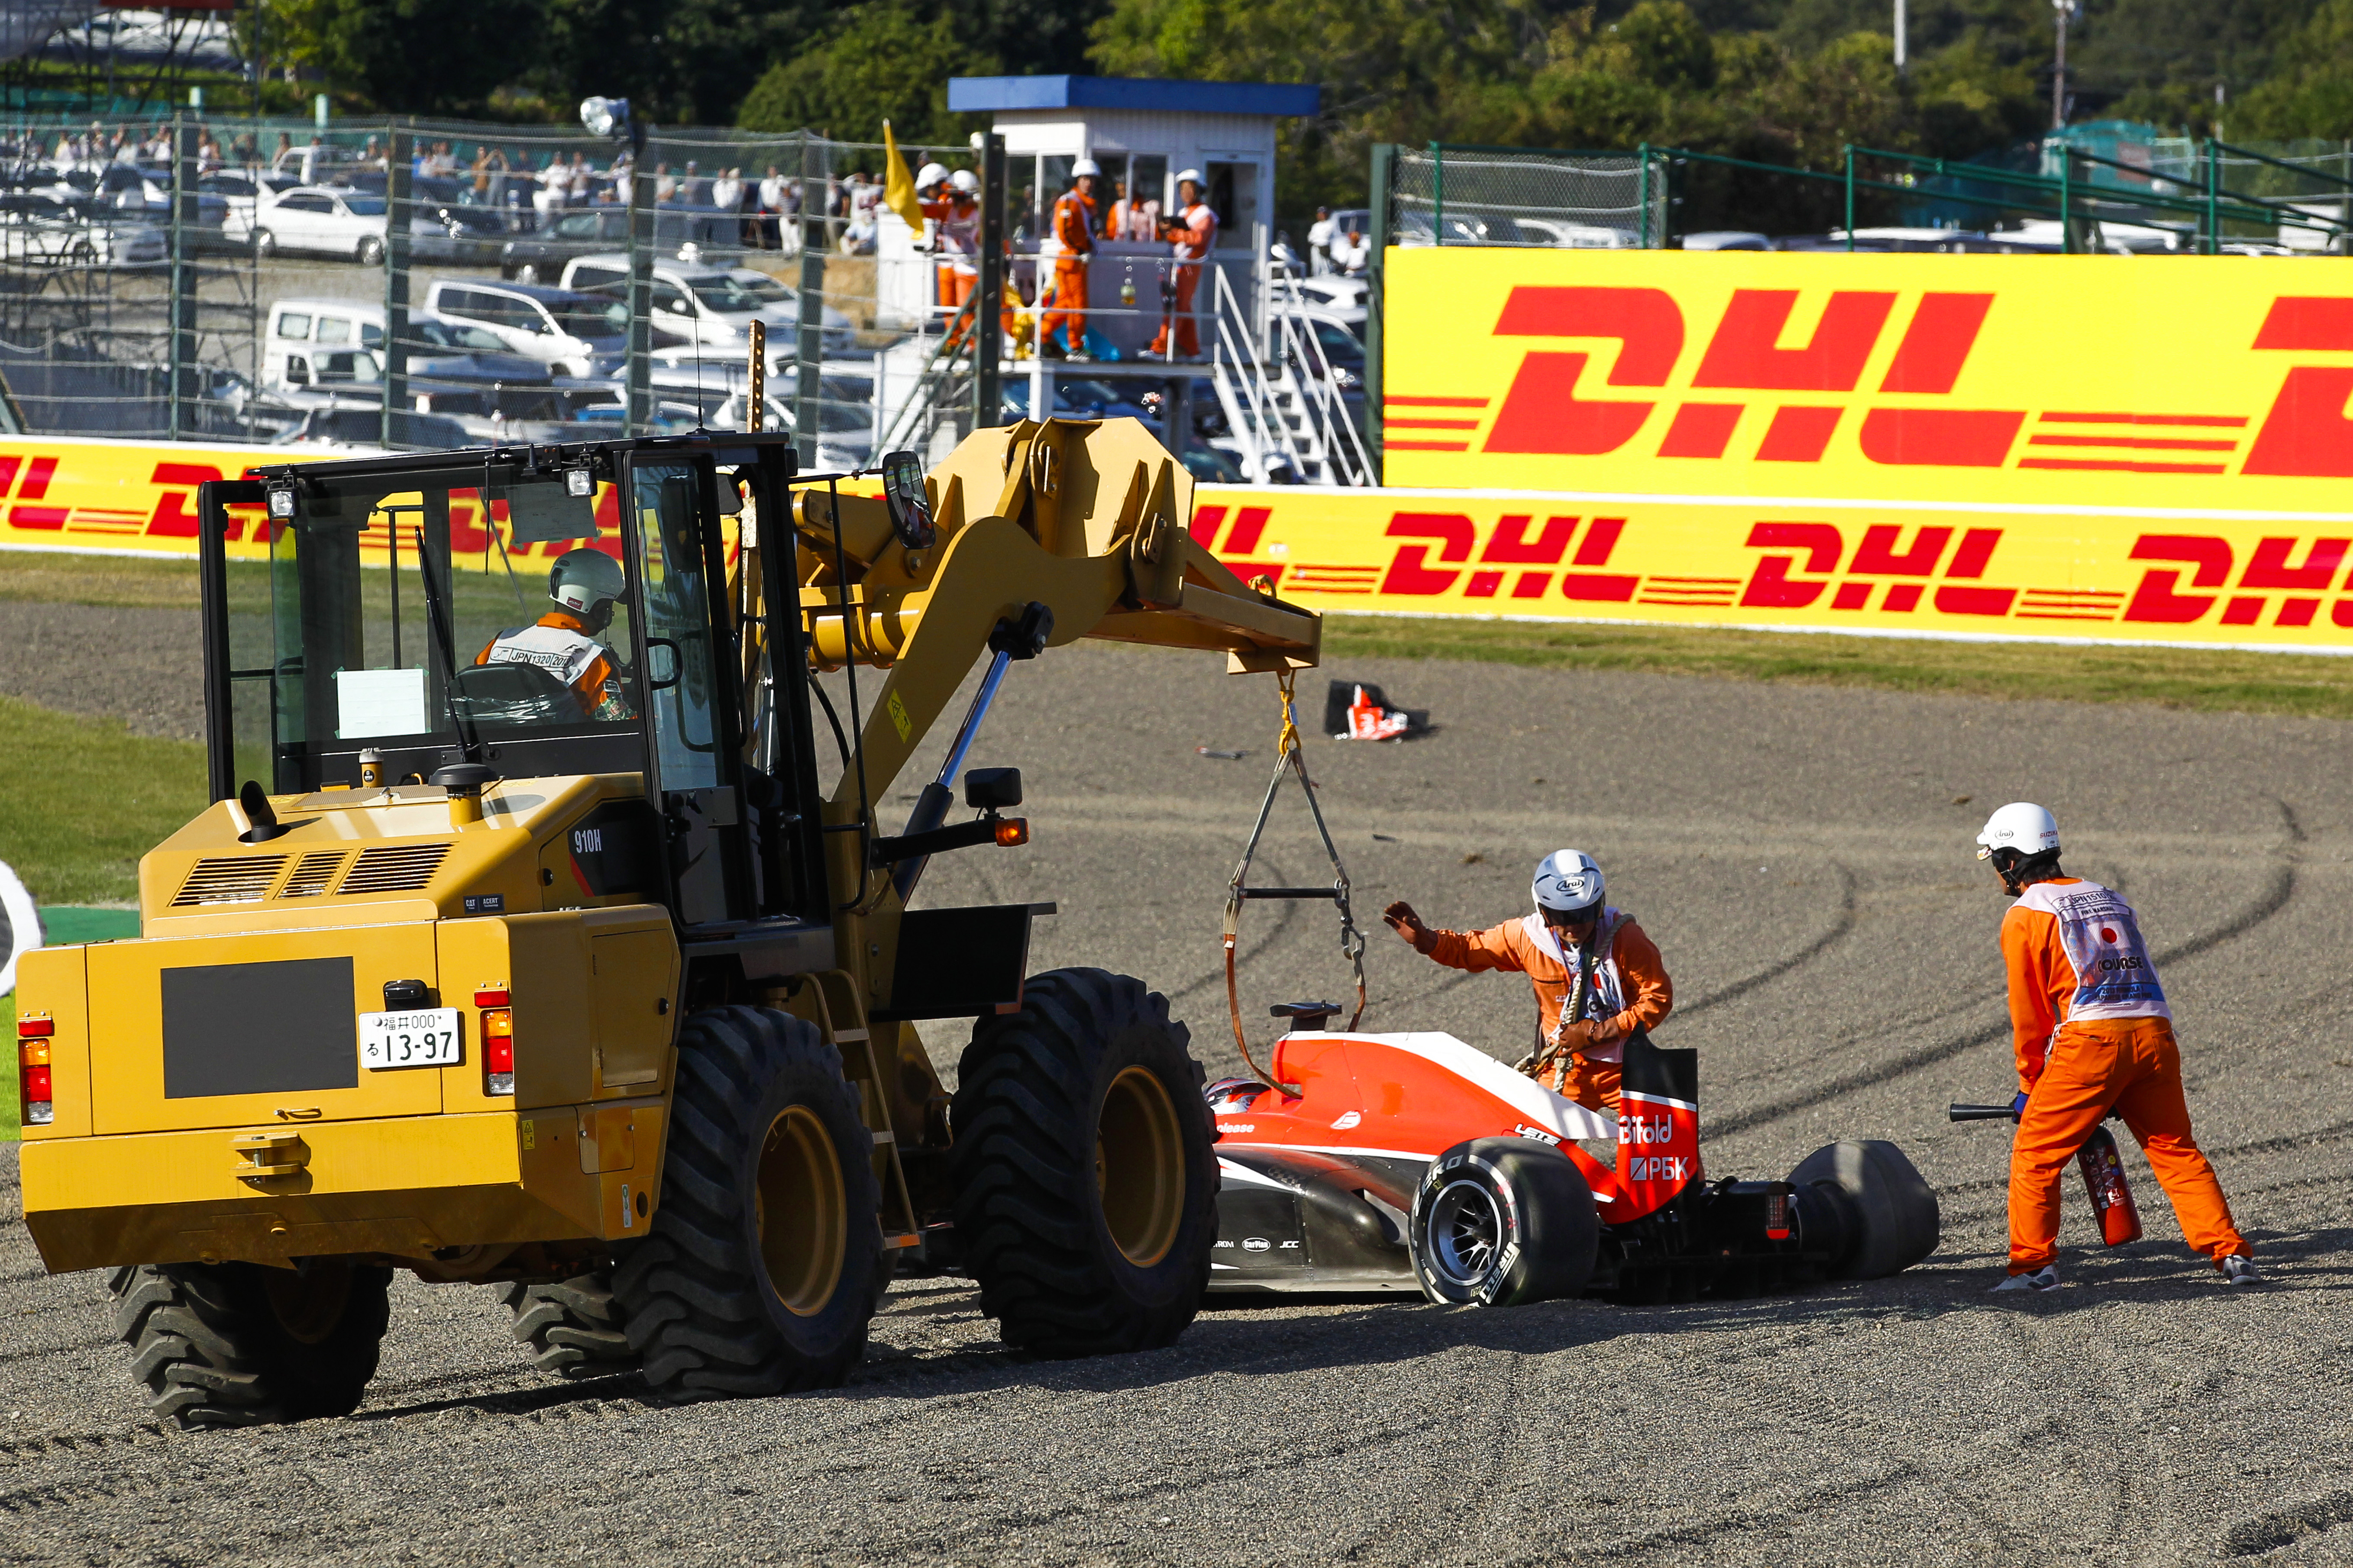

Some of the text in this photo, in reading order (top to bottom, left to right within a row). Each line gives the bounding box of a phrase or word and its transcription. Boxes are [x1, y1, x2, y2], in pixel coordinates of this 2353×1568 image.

[1484, 287, 2024, 466] DHL
[1380, 513, 1639, 601] DHL
[1740, 523, 2017, 615] DHL
[512, 652, 551, 664] JPN1320
[575, 829, 601, 853] 910H
[1561, 879, 1580, 888] Arai
[2072, 891, 2106, 904] JPN1510
[367, 1032, 452, 1062] る 13-97
[1619, 1114, 1672, 1144] Bifold
[1649, 1156, 1689, 1181] РБК
[1413, 1155, 1463, 1217] ZERO
[1479, 1241, 1521, 1304] PIRELLI
